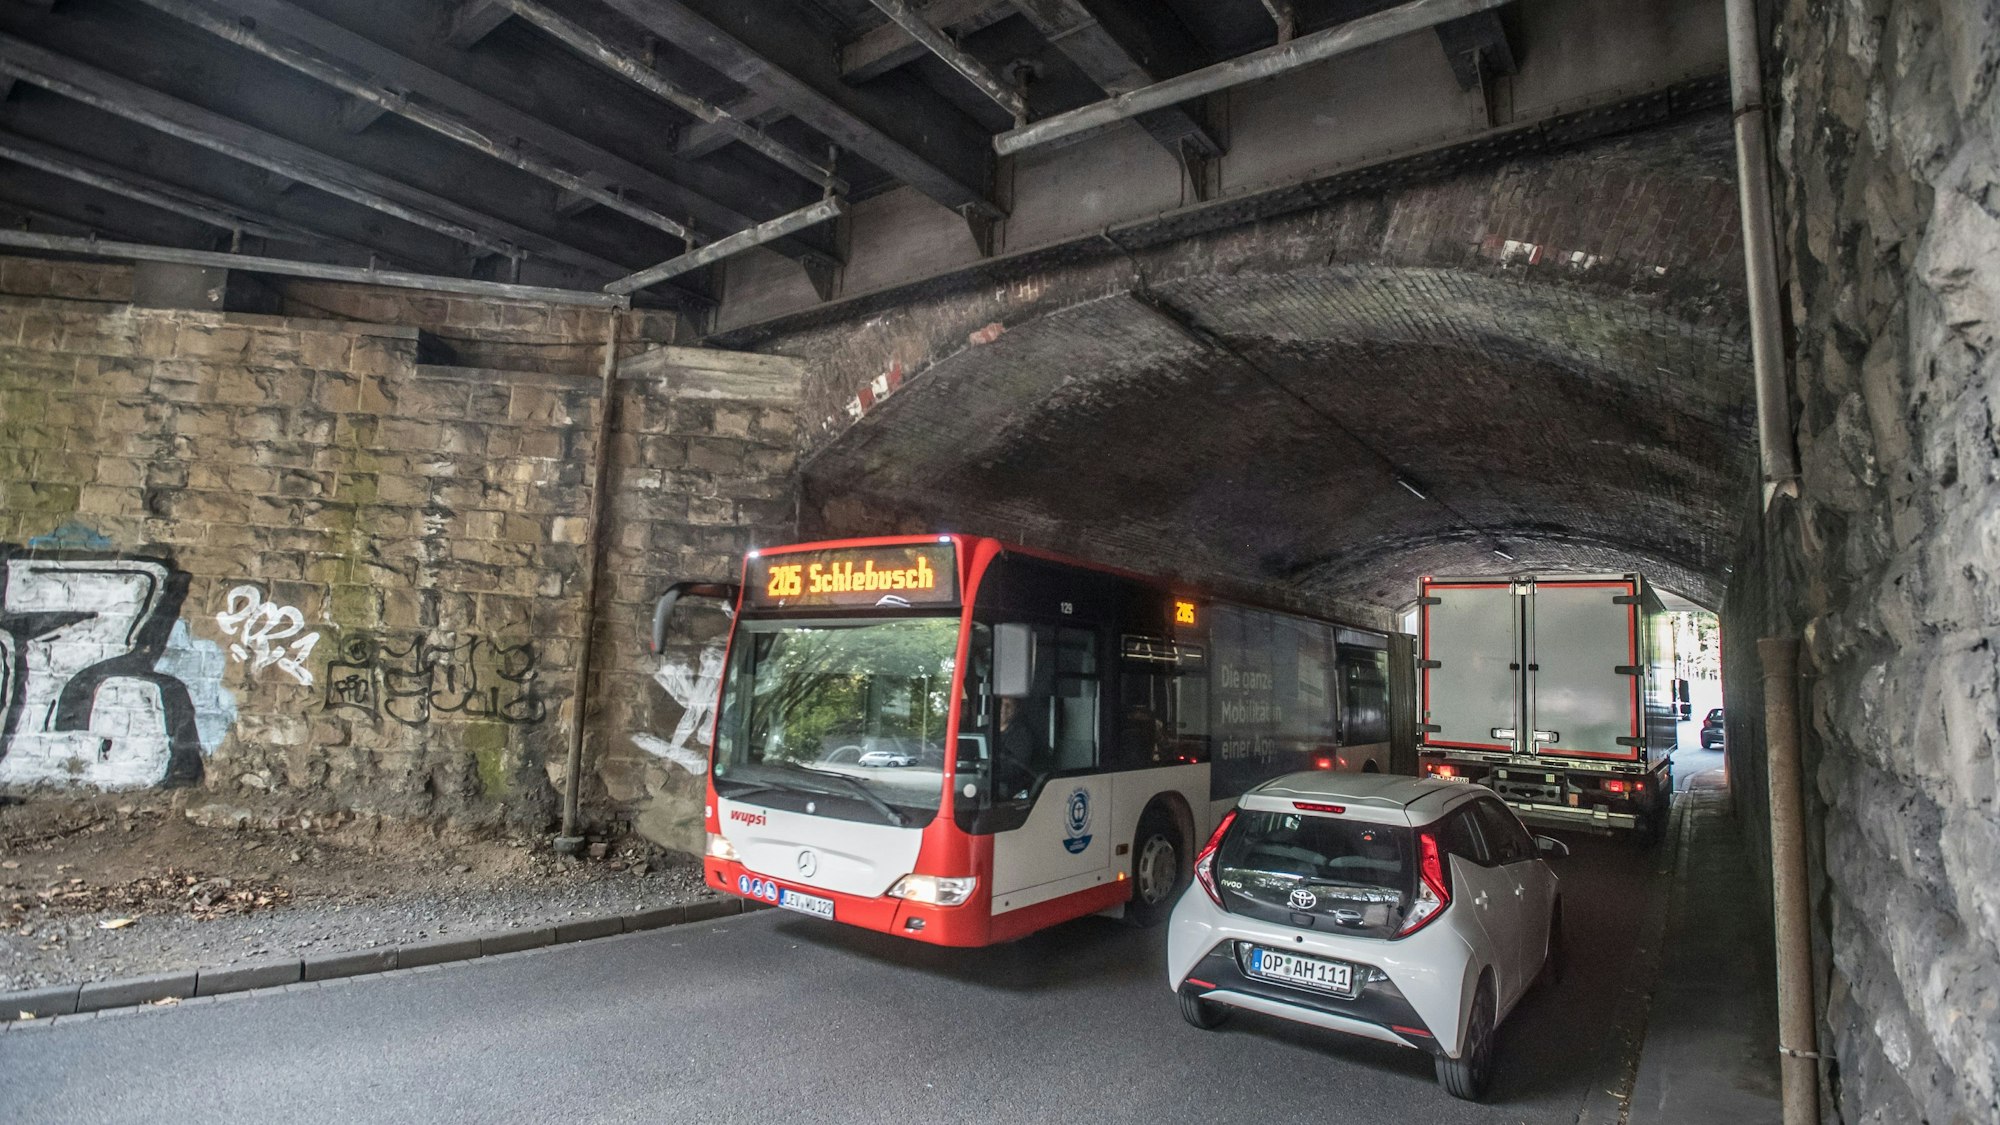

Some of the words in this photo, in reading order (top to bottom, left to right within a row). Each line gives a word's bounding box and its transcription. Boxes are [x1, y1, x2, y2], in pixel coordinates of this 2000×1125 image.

[768, 565, 802, 597] 205
[809, 556, 934, 593] Schlebusch
[1060, 602, 1073, 614] 129
[1221, 663, 1240, 689] Die
[1242, 671, 1273, 696] ganze
[1221, 735, 1251, 760] einer
[731, 810, 766, 826] wupsi
[818, 900, 833, 915] 129
[1262, 954, 1284, 972] OP
[1293, 960, 1315, 979] AH
[1317, 964, 1348, 987] 111
